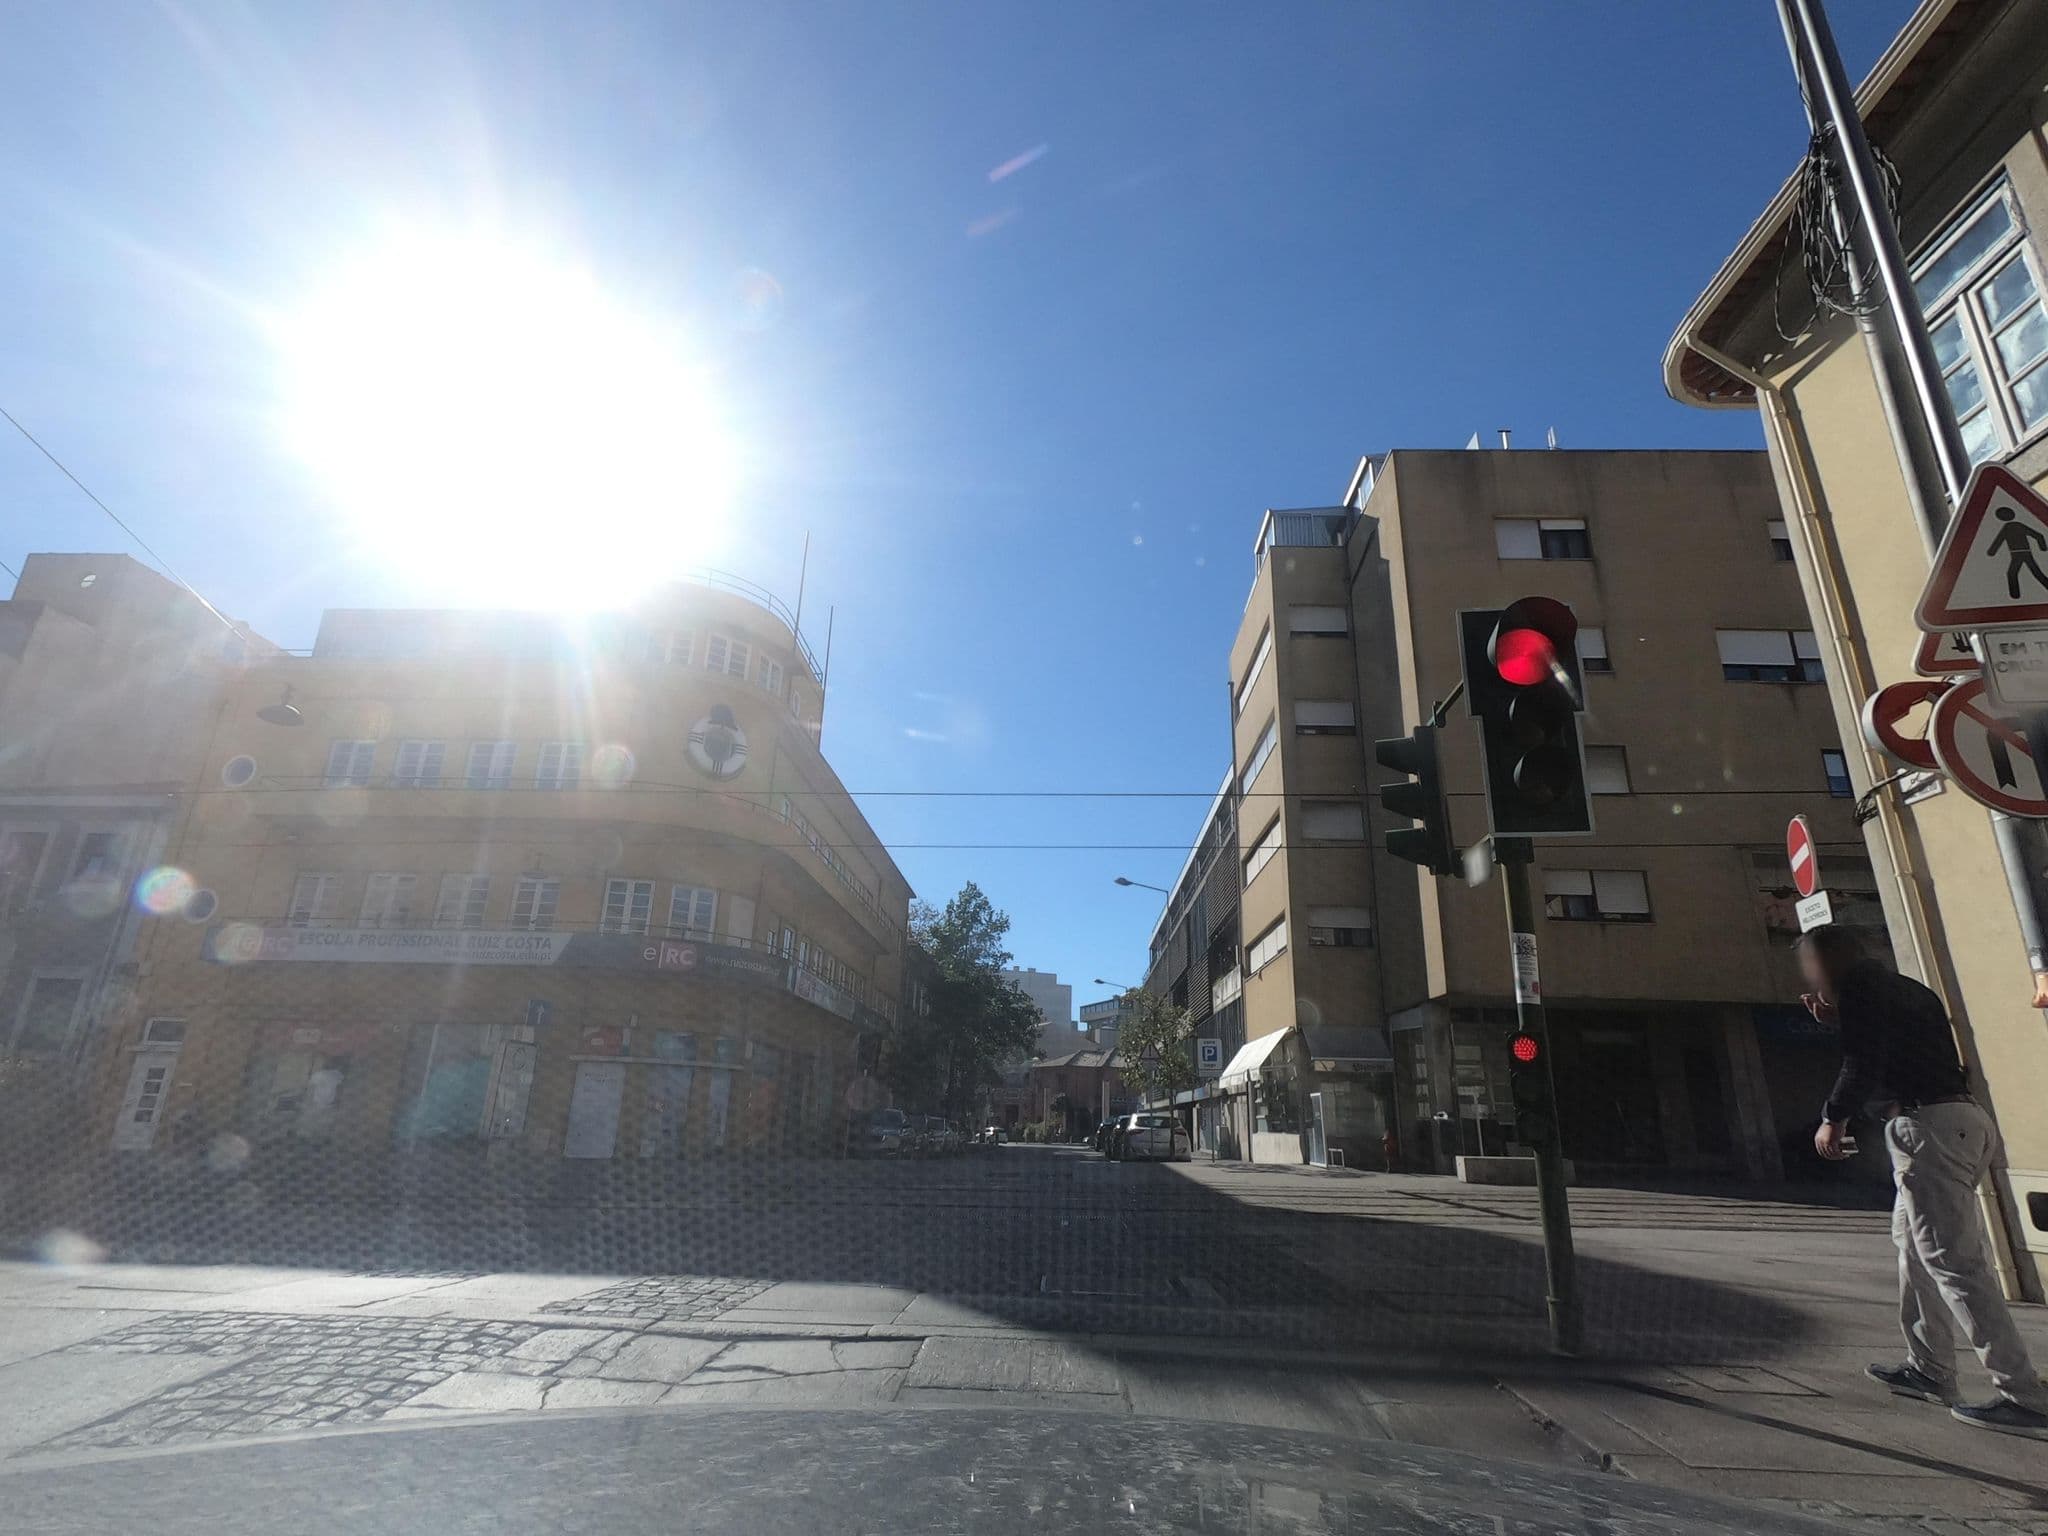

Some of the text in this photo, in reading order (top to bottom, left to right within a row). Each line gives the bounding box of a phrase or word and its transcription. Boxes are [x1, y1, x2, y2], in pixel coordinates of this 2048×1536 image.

[299, 932, 354, 946] ESCOLA
[505, 936, 552, 950] COSTA
[1204, 1047, 1215, 1060] P
